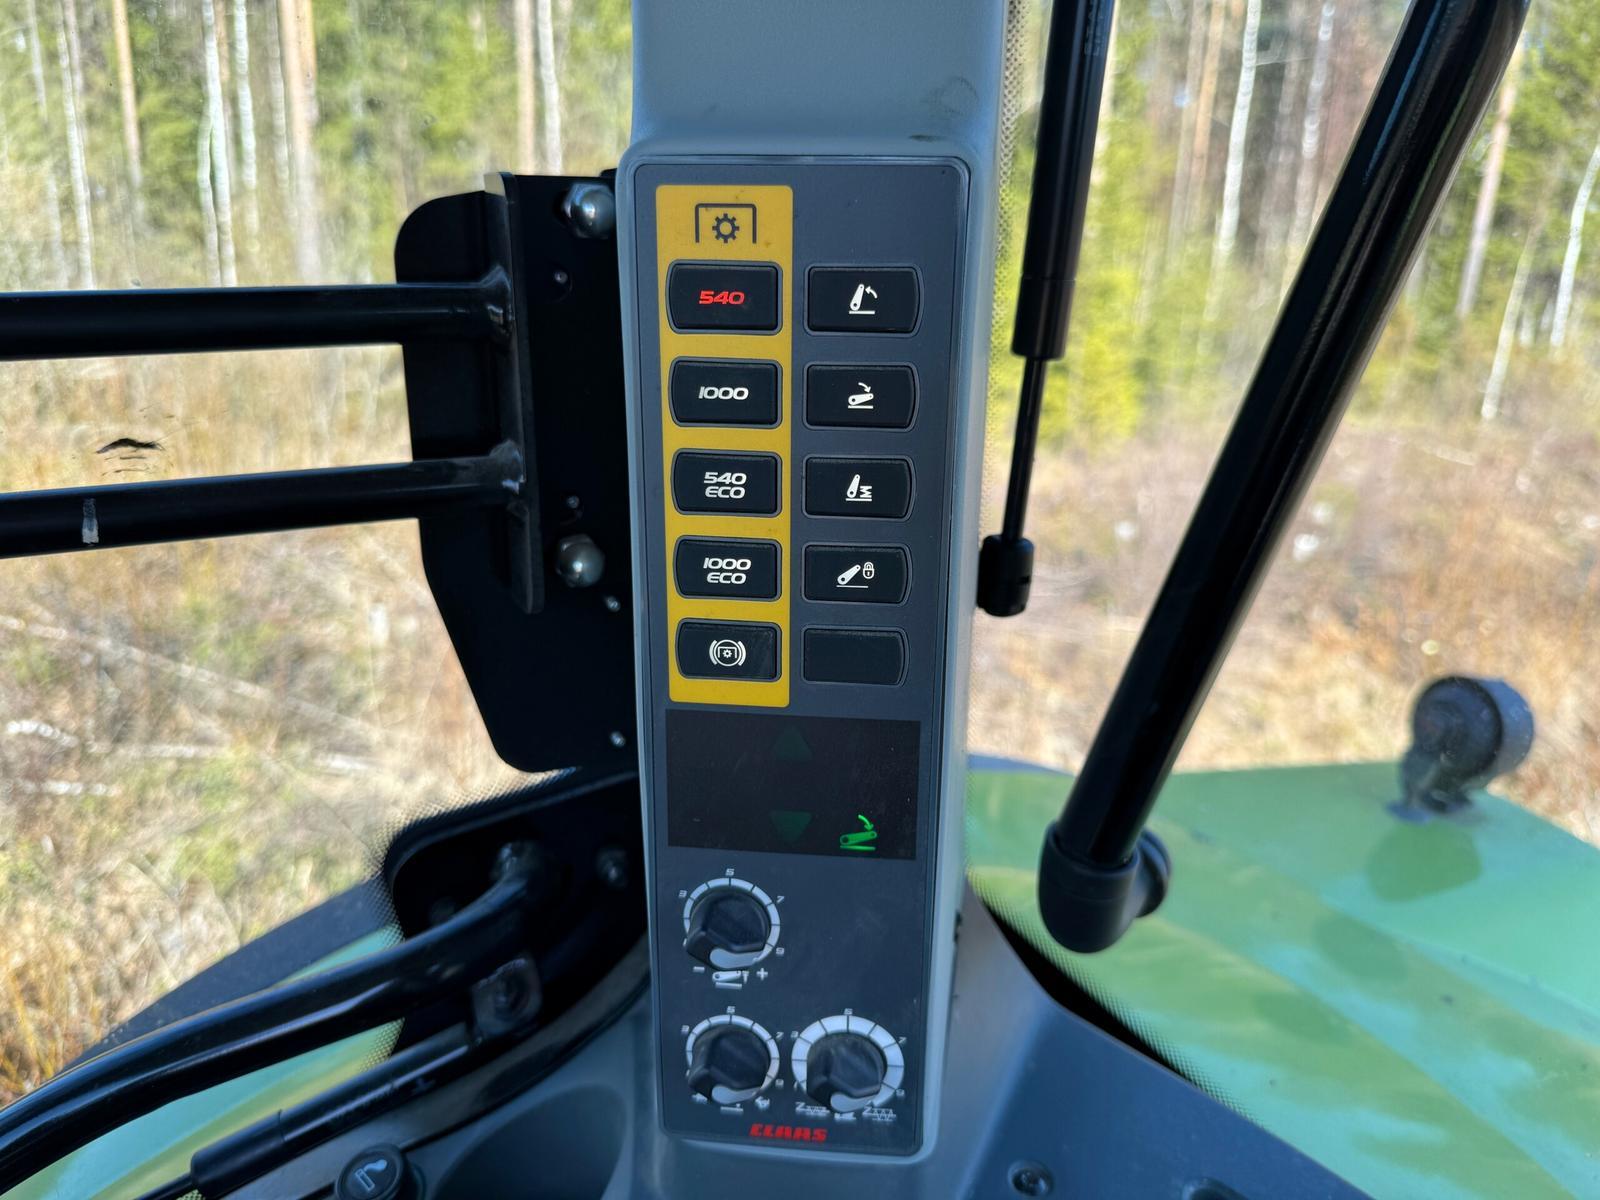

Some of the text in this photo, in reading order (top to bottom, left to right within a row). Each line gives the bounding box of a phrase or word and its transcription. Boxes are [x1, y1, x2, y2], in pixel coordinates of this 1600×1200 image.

[699, 290, 745, 305] 540
[699, 386, 748, 400] 1000
[704, 472, 747, 485] 540
[705, 486, 745, 499] ECO
[703, 557, 751, 570] 1000
[707, 572, 746, 584] ECO
[749, 1123, 827, 1142] CLAAS
